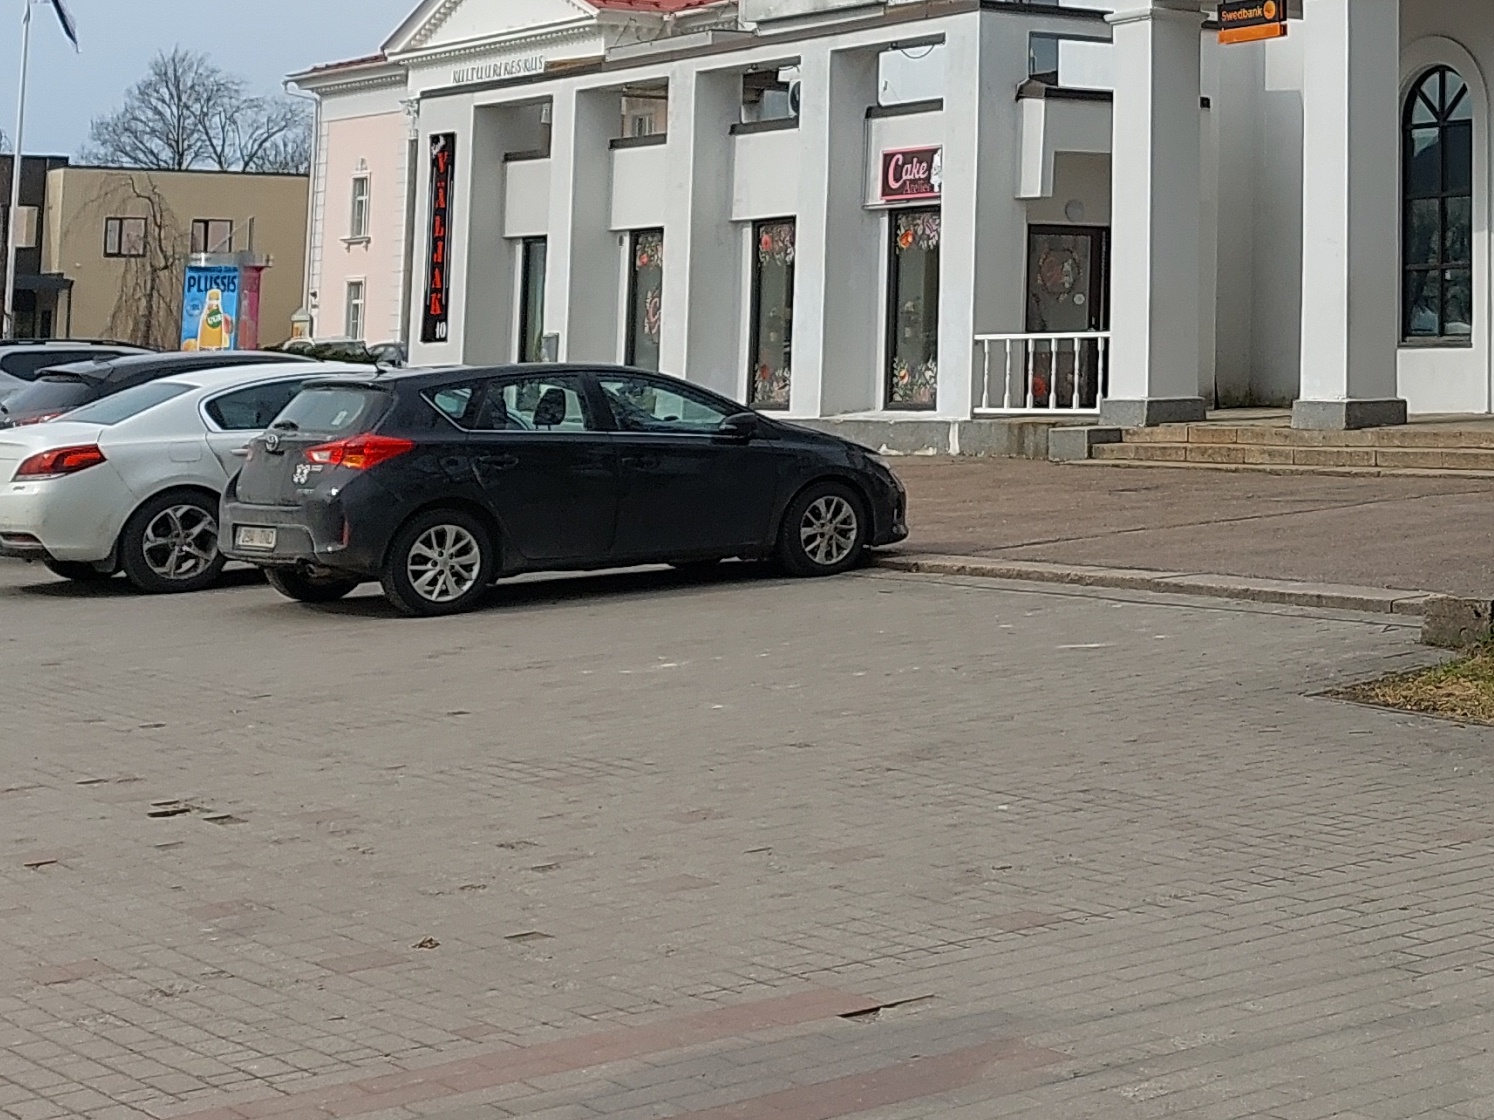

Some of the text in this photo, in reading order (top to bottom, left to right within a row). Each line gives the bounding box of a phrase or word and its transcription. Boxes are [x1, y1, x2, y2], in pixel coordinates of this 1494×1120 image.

[1221, 6, 1263, 21] Swedbank
[888, 154, 929, 189] Cake
[187, 275, 237, 293] PLUSSIS
[435, 321, 447, 339] 10
